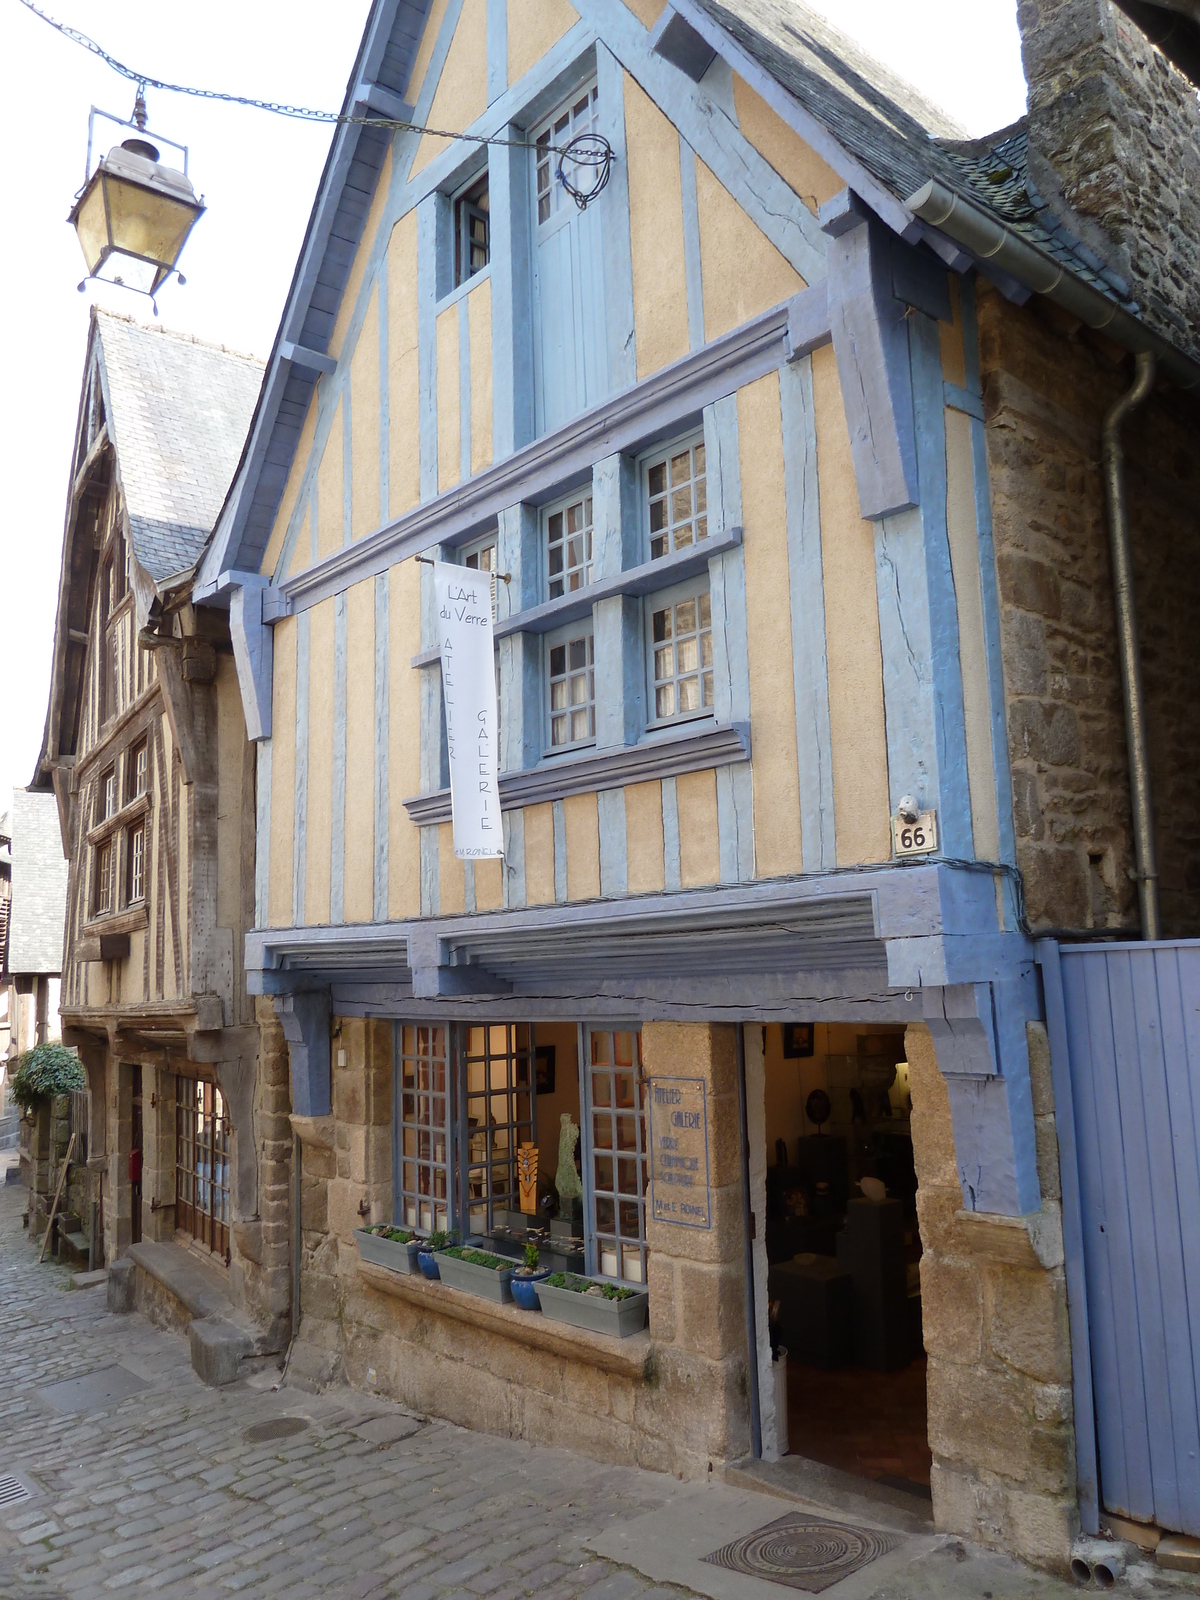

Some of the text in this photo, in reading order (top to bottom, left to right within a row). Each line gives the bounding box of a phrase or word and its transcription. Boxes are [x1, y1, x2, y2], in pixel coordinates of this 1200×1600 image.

[448, 585, 477, 604] L'Art
[440, 605, 488, 626] du Verre
[444, 638, 456, 760] ATELIER
[901, 827, 925, 849] 66
[654, 1087, 682, 1105] ATELIER
[670, 1110, 701, 1130] GALERIE
